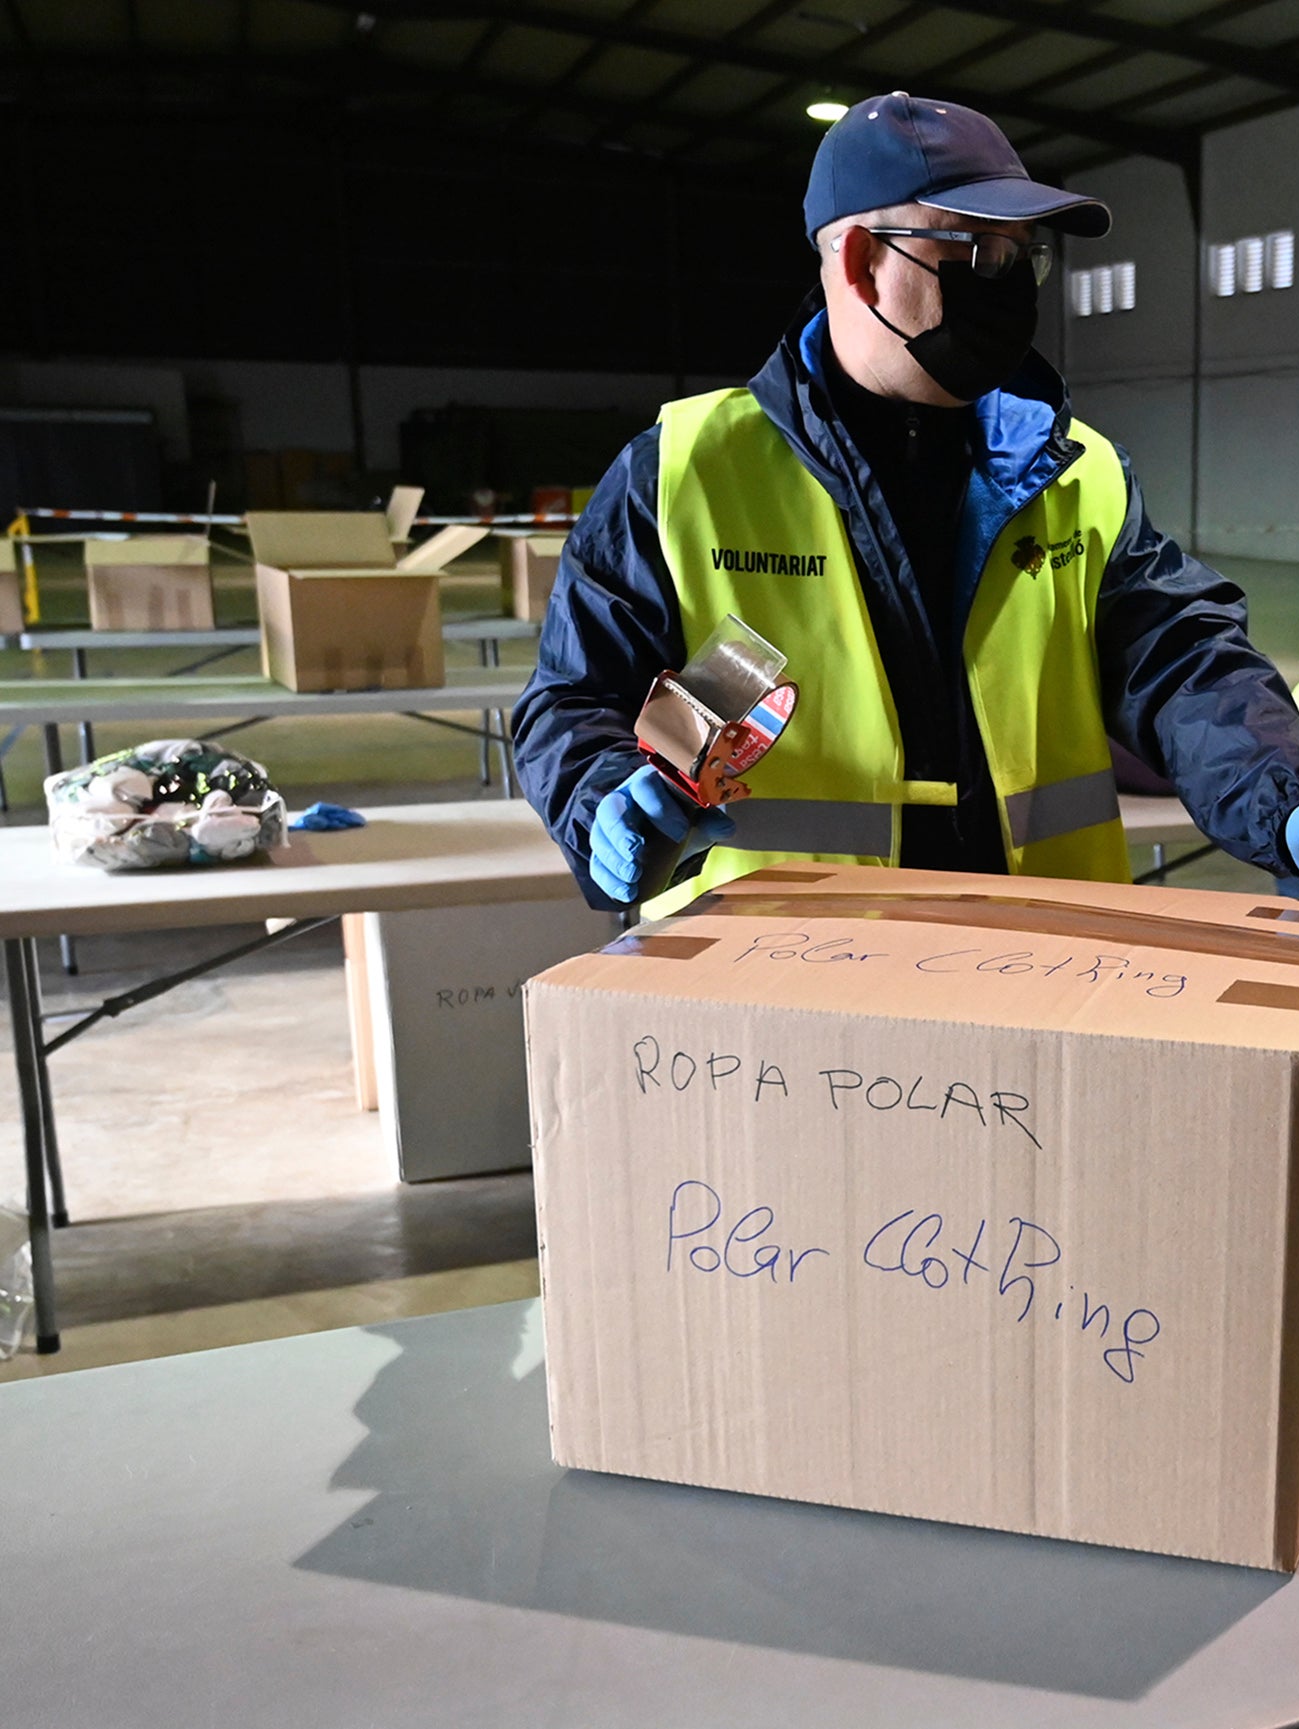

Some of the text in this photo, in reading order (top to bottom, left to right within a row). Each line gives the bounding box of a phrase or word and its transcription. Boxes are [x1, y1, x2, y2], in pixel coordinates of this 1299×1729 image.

[711, 548, 827, 577] VOLUNTARIAT
[734, 932, 890, 964] Polar
[436, 984, 496, 1009] ROPA
[633, 1035, 1043, 1150] ROPA POLAR
[667, 1180, 831, 1284] Polar
